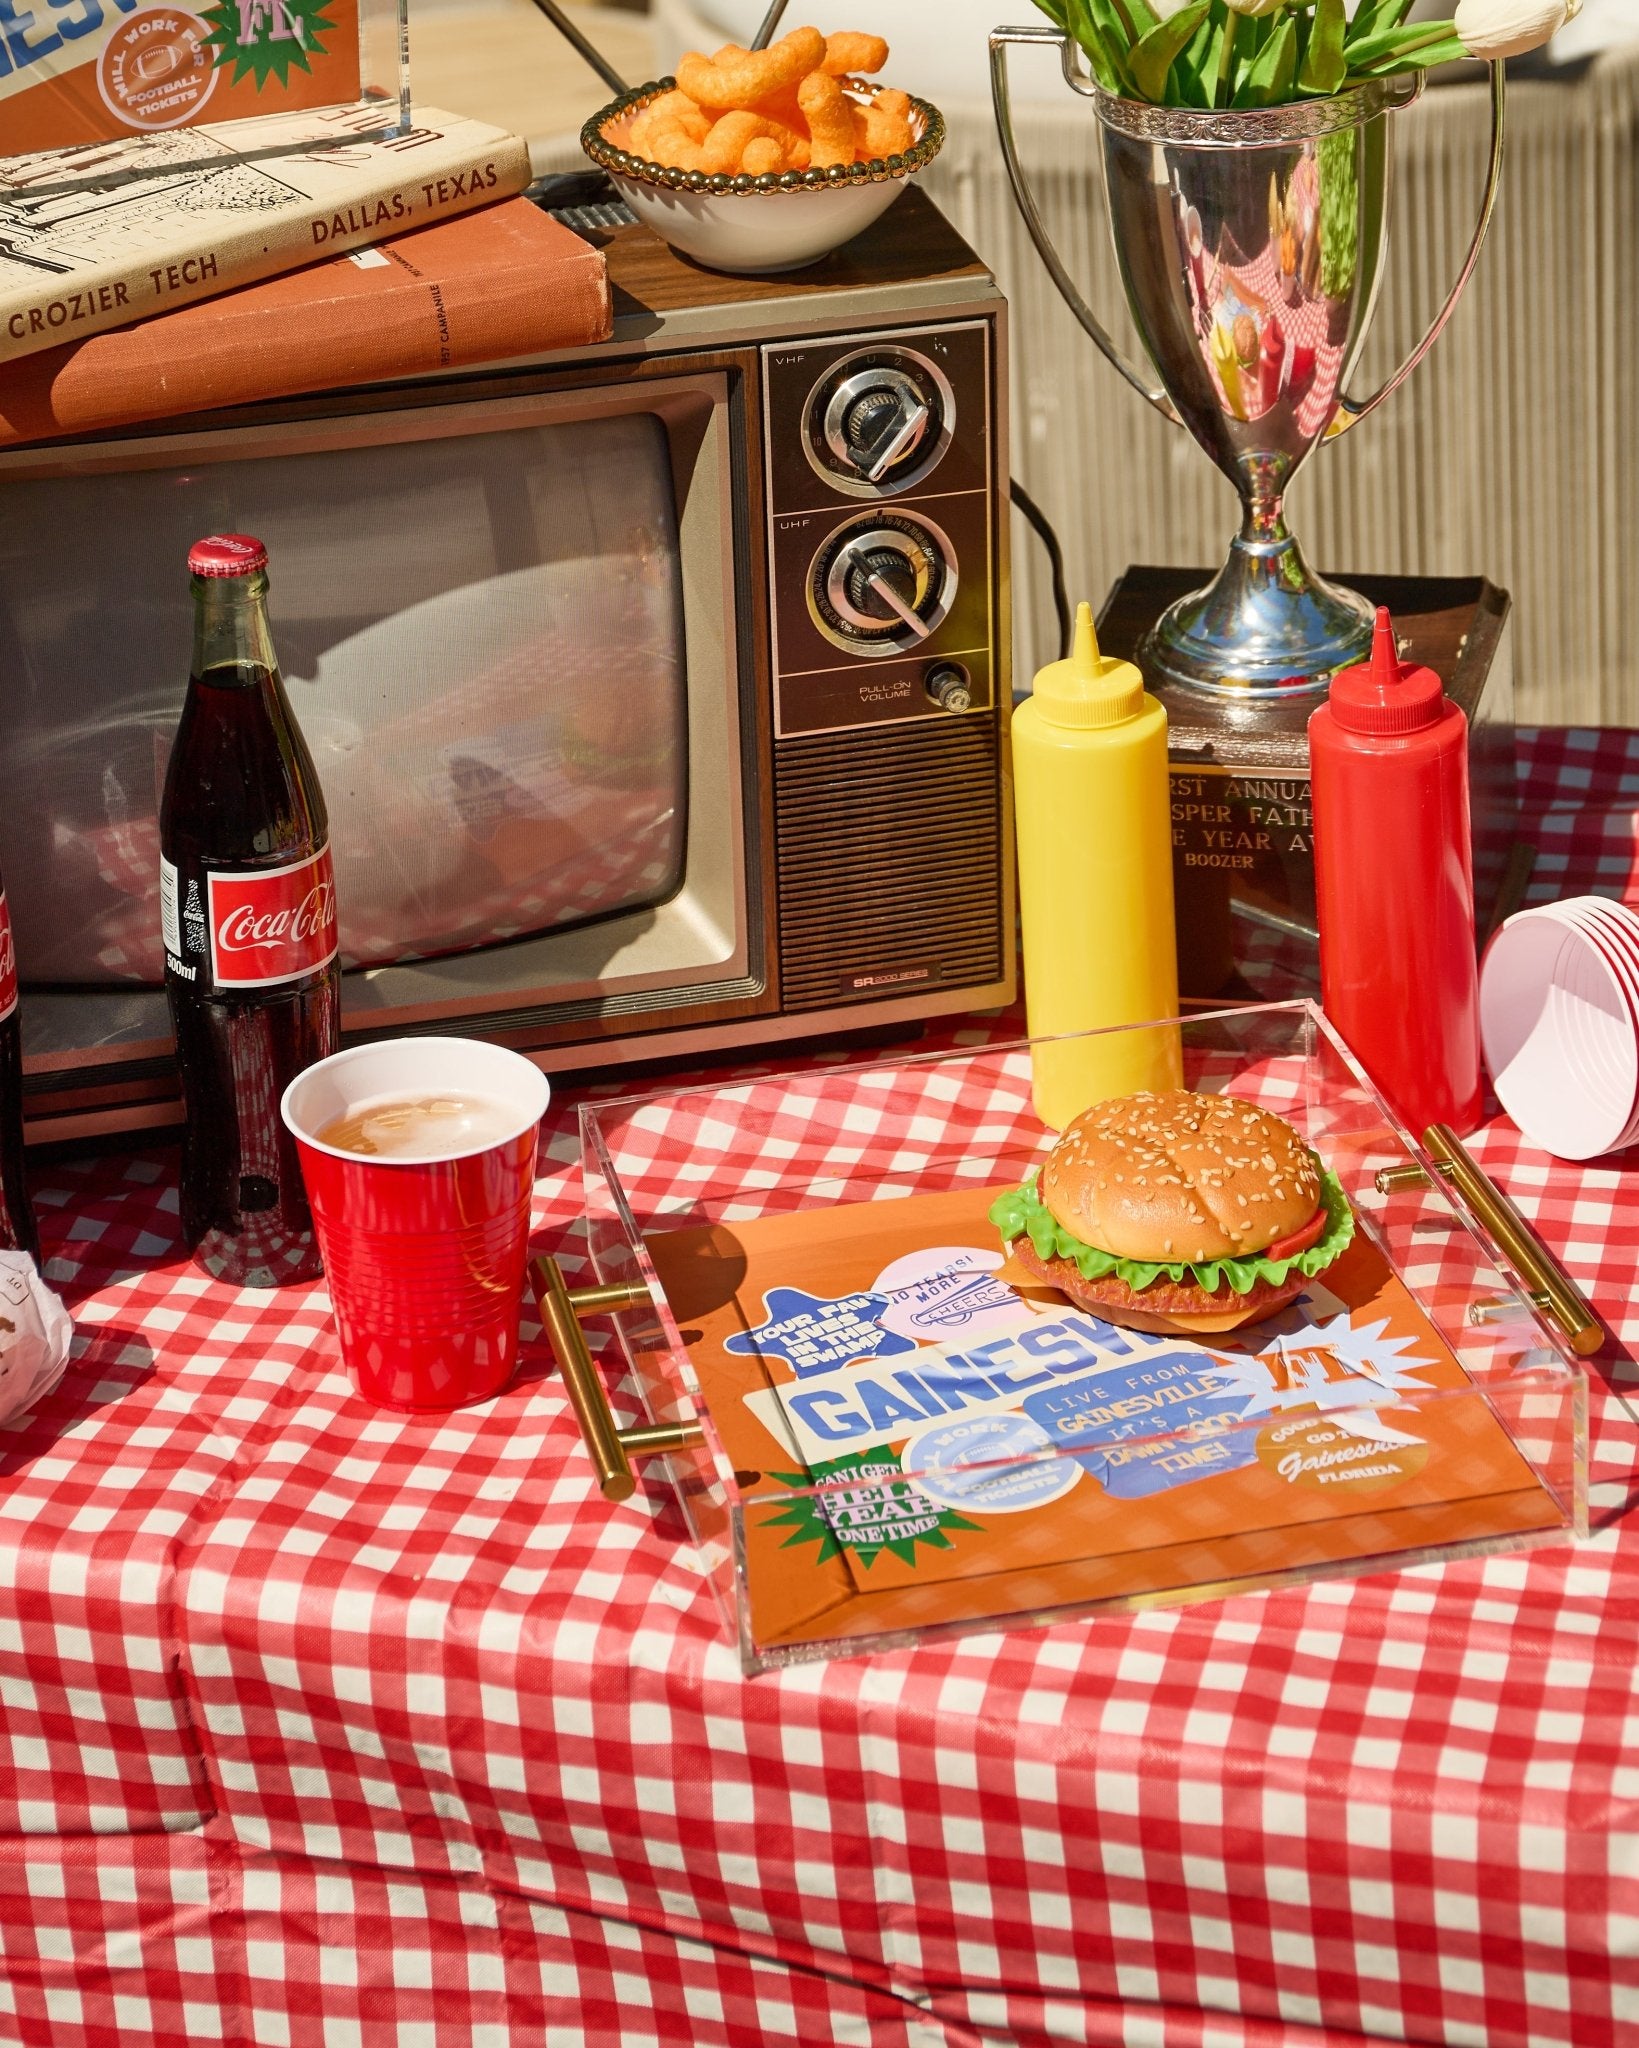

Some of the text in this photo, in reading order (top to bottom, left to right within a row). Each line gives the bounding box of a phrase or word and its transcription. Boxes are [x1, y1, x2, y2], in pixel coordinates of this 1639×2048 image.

[234, 0, 304, 46] FL
[111, 19, 205, 99] WILL WORK FOR
[126, 74, 202, 106] FOOTBALL
[136, 88, 198, 117] TICKETS
[7, 163, 499, 340] CROZIER TECH DALLAS, TEXAS
[429, 284, 450, 343] CAMPANILE
[775, 355, 805, 366] VHF
[894, 357, 902, 366] 2
[915, 374, 924, 382] 3
[780, 519, 811, 530] UHF
[859, 681, 911, 694] PULL-ON
[860, 690, 912, 702] VOLUME
[1202, 830, 1272, 850] YEAR
[1184, 853, 1255, 869] BOOZER
[218, 873, 336, 952] Coca-Cola
[167, 953, 197, 982] 500ml
[853, 977, 874, 988] SR
[915, 1273, 962, 1304] MORE
[928, 1286, 1006, 1320] CHEERS
[750, 1313, 817, 1345] YOUR
[779, 1312, 860, 1347] LIVES
[785, 1320, 877, 1358] IN THE
[795, 1329, 886, 1368] SWAMP
[789, 1313, 1164, 1441] GAINESV
[1045, 1363, 1191, 1414] LIVE FROM
[1056, 1375, 1226, 1435] GAINESVILLE
[933, 1422, 1009, 1447] WORK
[1107, 1406, 1203, 1441] IT'S A
[1150, 1441, 1232, 1474] TIME!
[1316, 1462, 1403, 1485] FLORIDA
[812, 1482, 921, 1511] HEL
[812, 1496, 949, 1529] YEAH
[835, 1515, 940, 1544] ONE TIME
